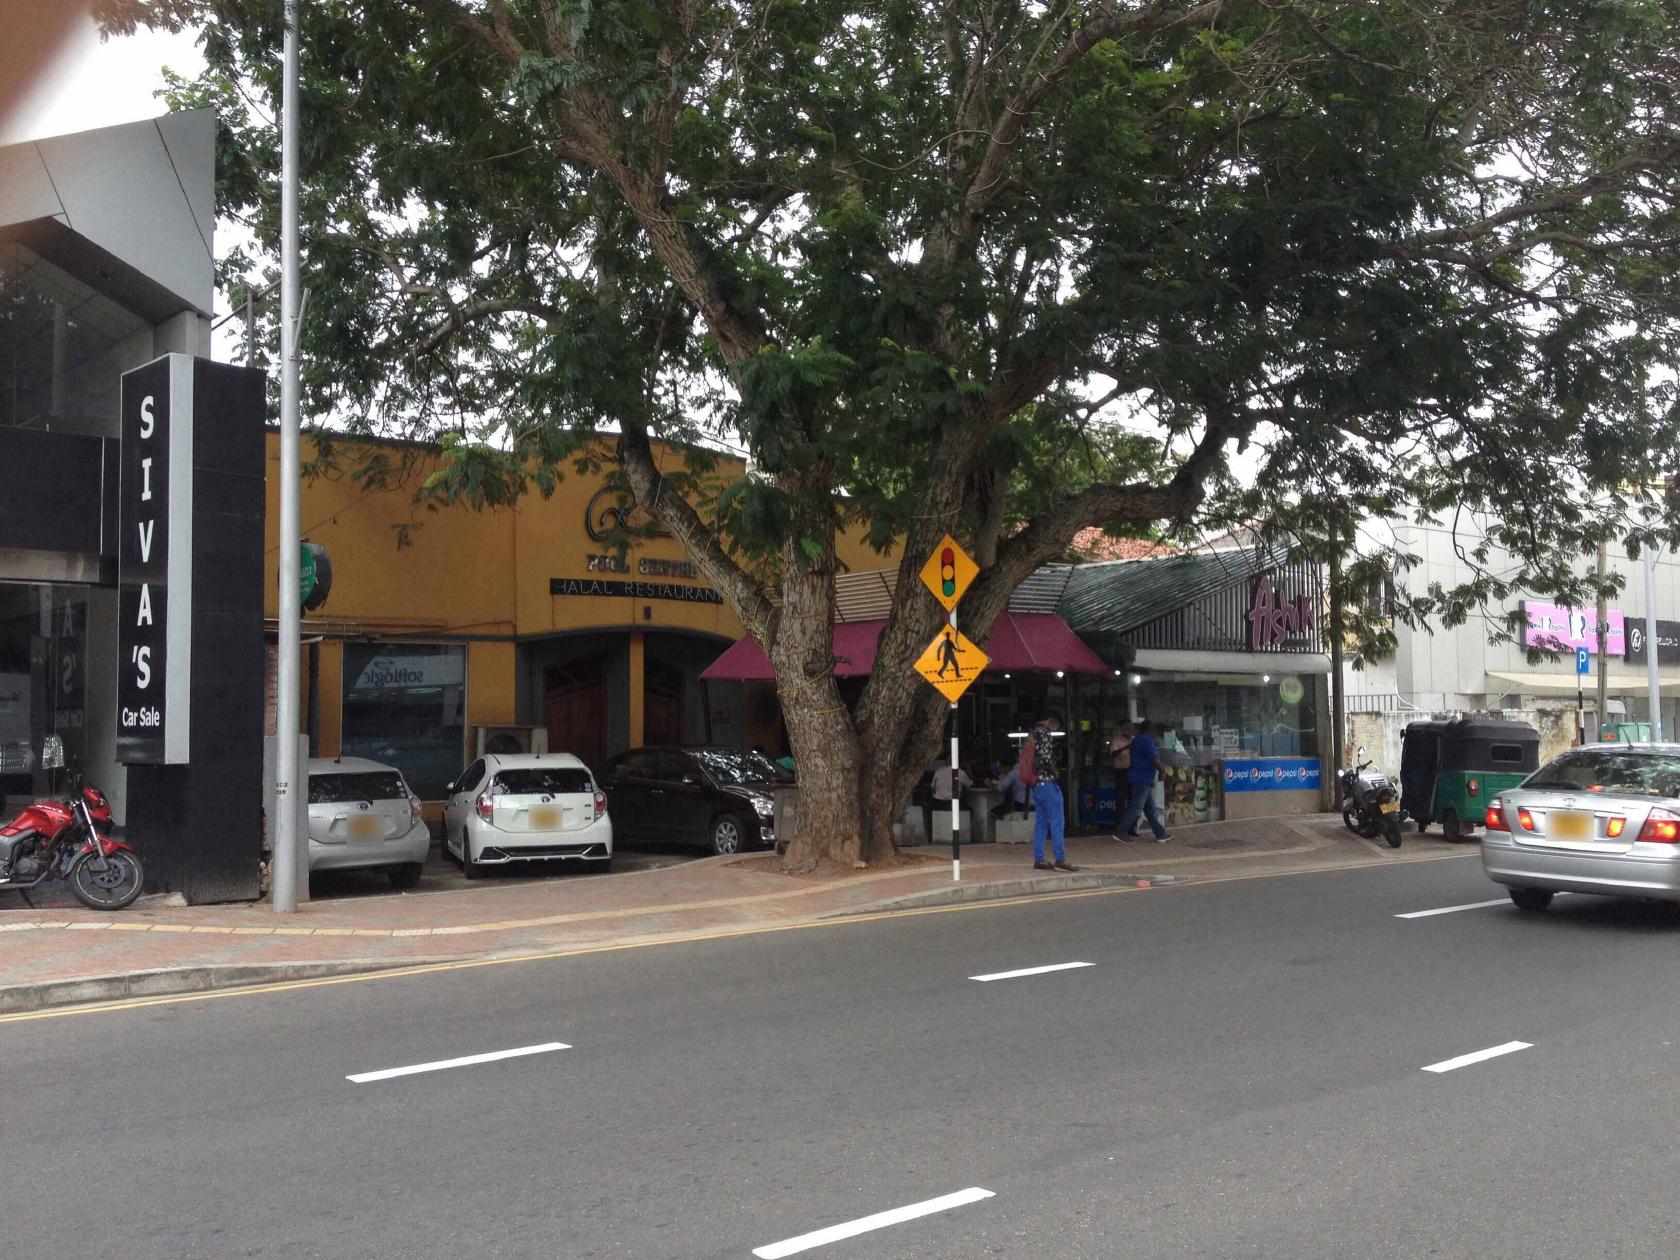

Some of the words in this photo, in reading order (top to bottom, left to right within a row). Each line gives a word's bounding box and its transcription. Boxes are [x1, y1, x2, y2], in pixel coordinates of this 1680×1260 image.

[1579, 650, 1586, 670] P
[122, 707, 138, 727] Car
[140, 706, 160, 727] Sale
[1233, 770, 1249, 780] pepsi
[1259, 769, 1274, 779] pepsi
[1283, 768, 1297, 779] pepsi
[1306, 768, 1319, 778] pepsi
